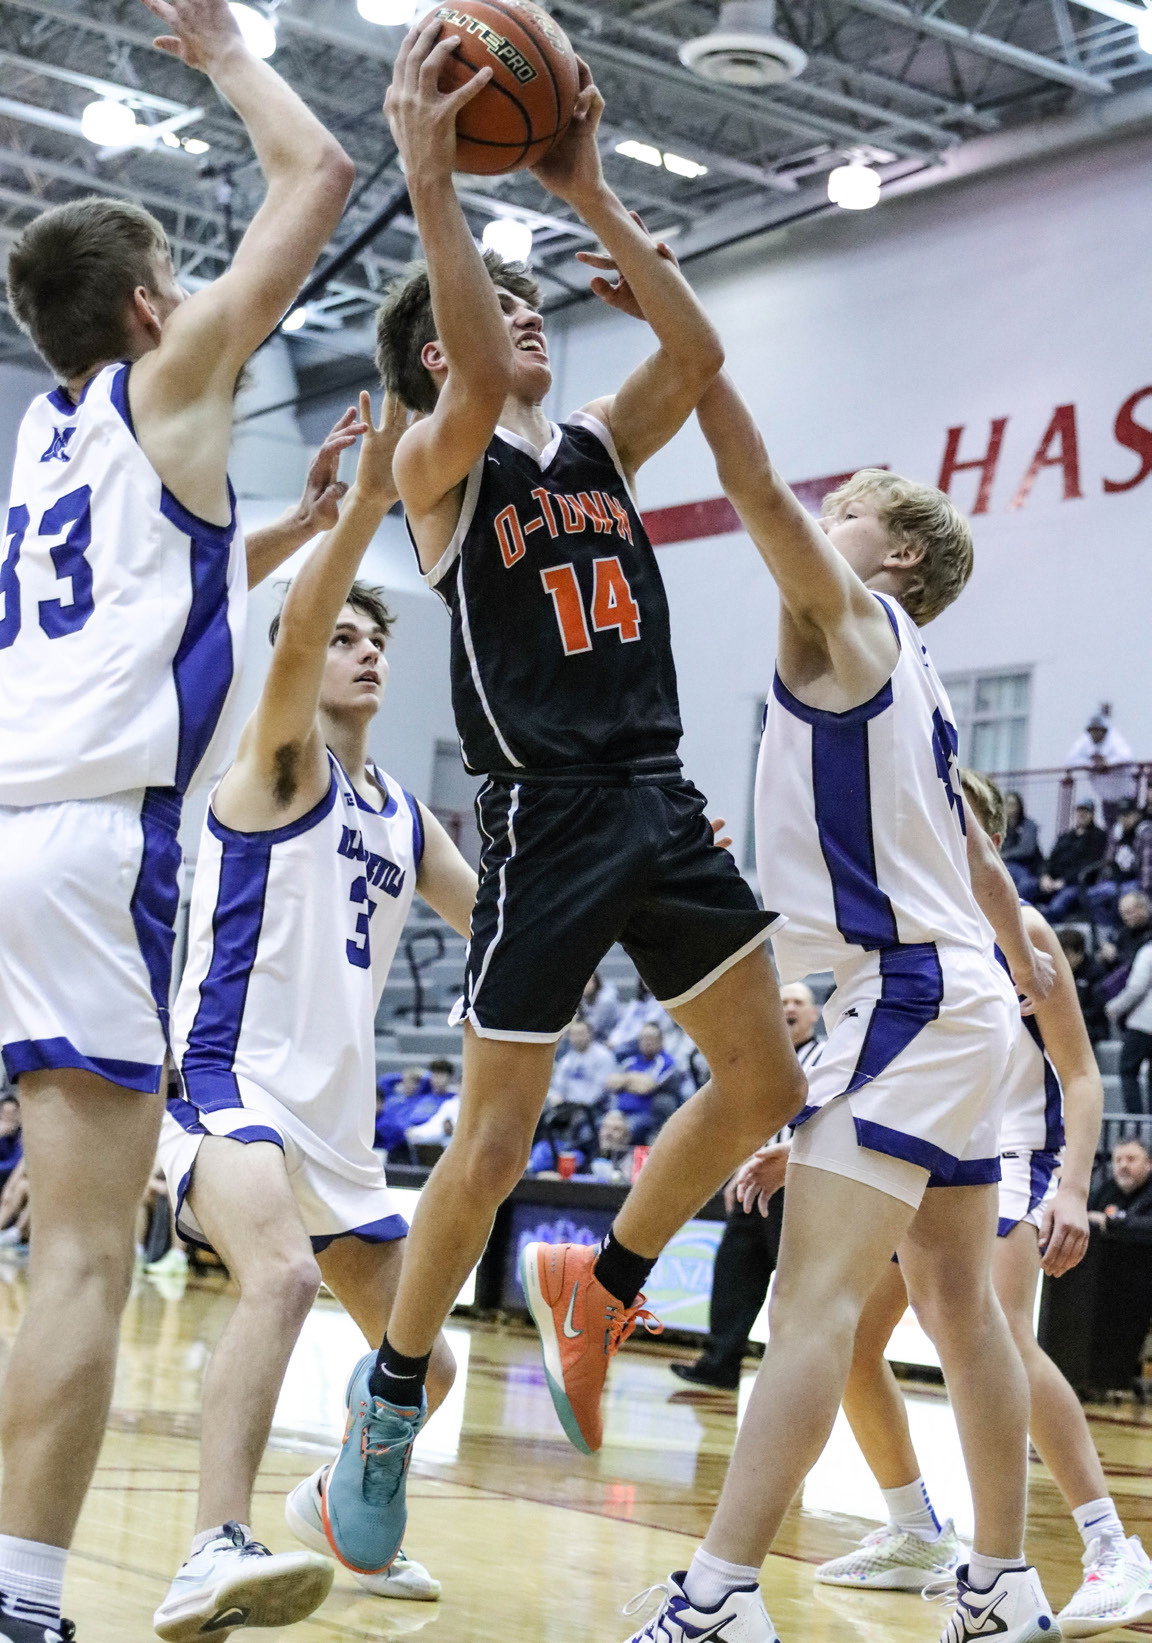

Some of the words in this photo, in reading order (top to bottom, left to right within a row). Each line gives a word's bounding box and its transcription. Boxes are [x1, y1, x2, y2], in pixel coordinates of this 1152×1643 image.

[433, 8, 505, 54] ELITE
[499, 46, 536, 83] PRO
[936, 385, 1152, 516] HAS
[494, 486, 634, 568] O-TOWN
[539, 556, 641, 656] 14
[346, 876, 377, 970] 3
